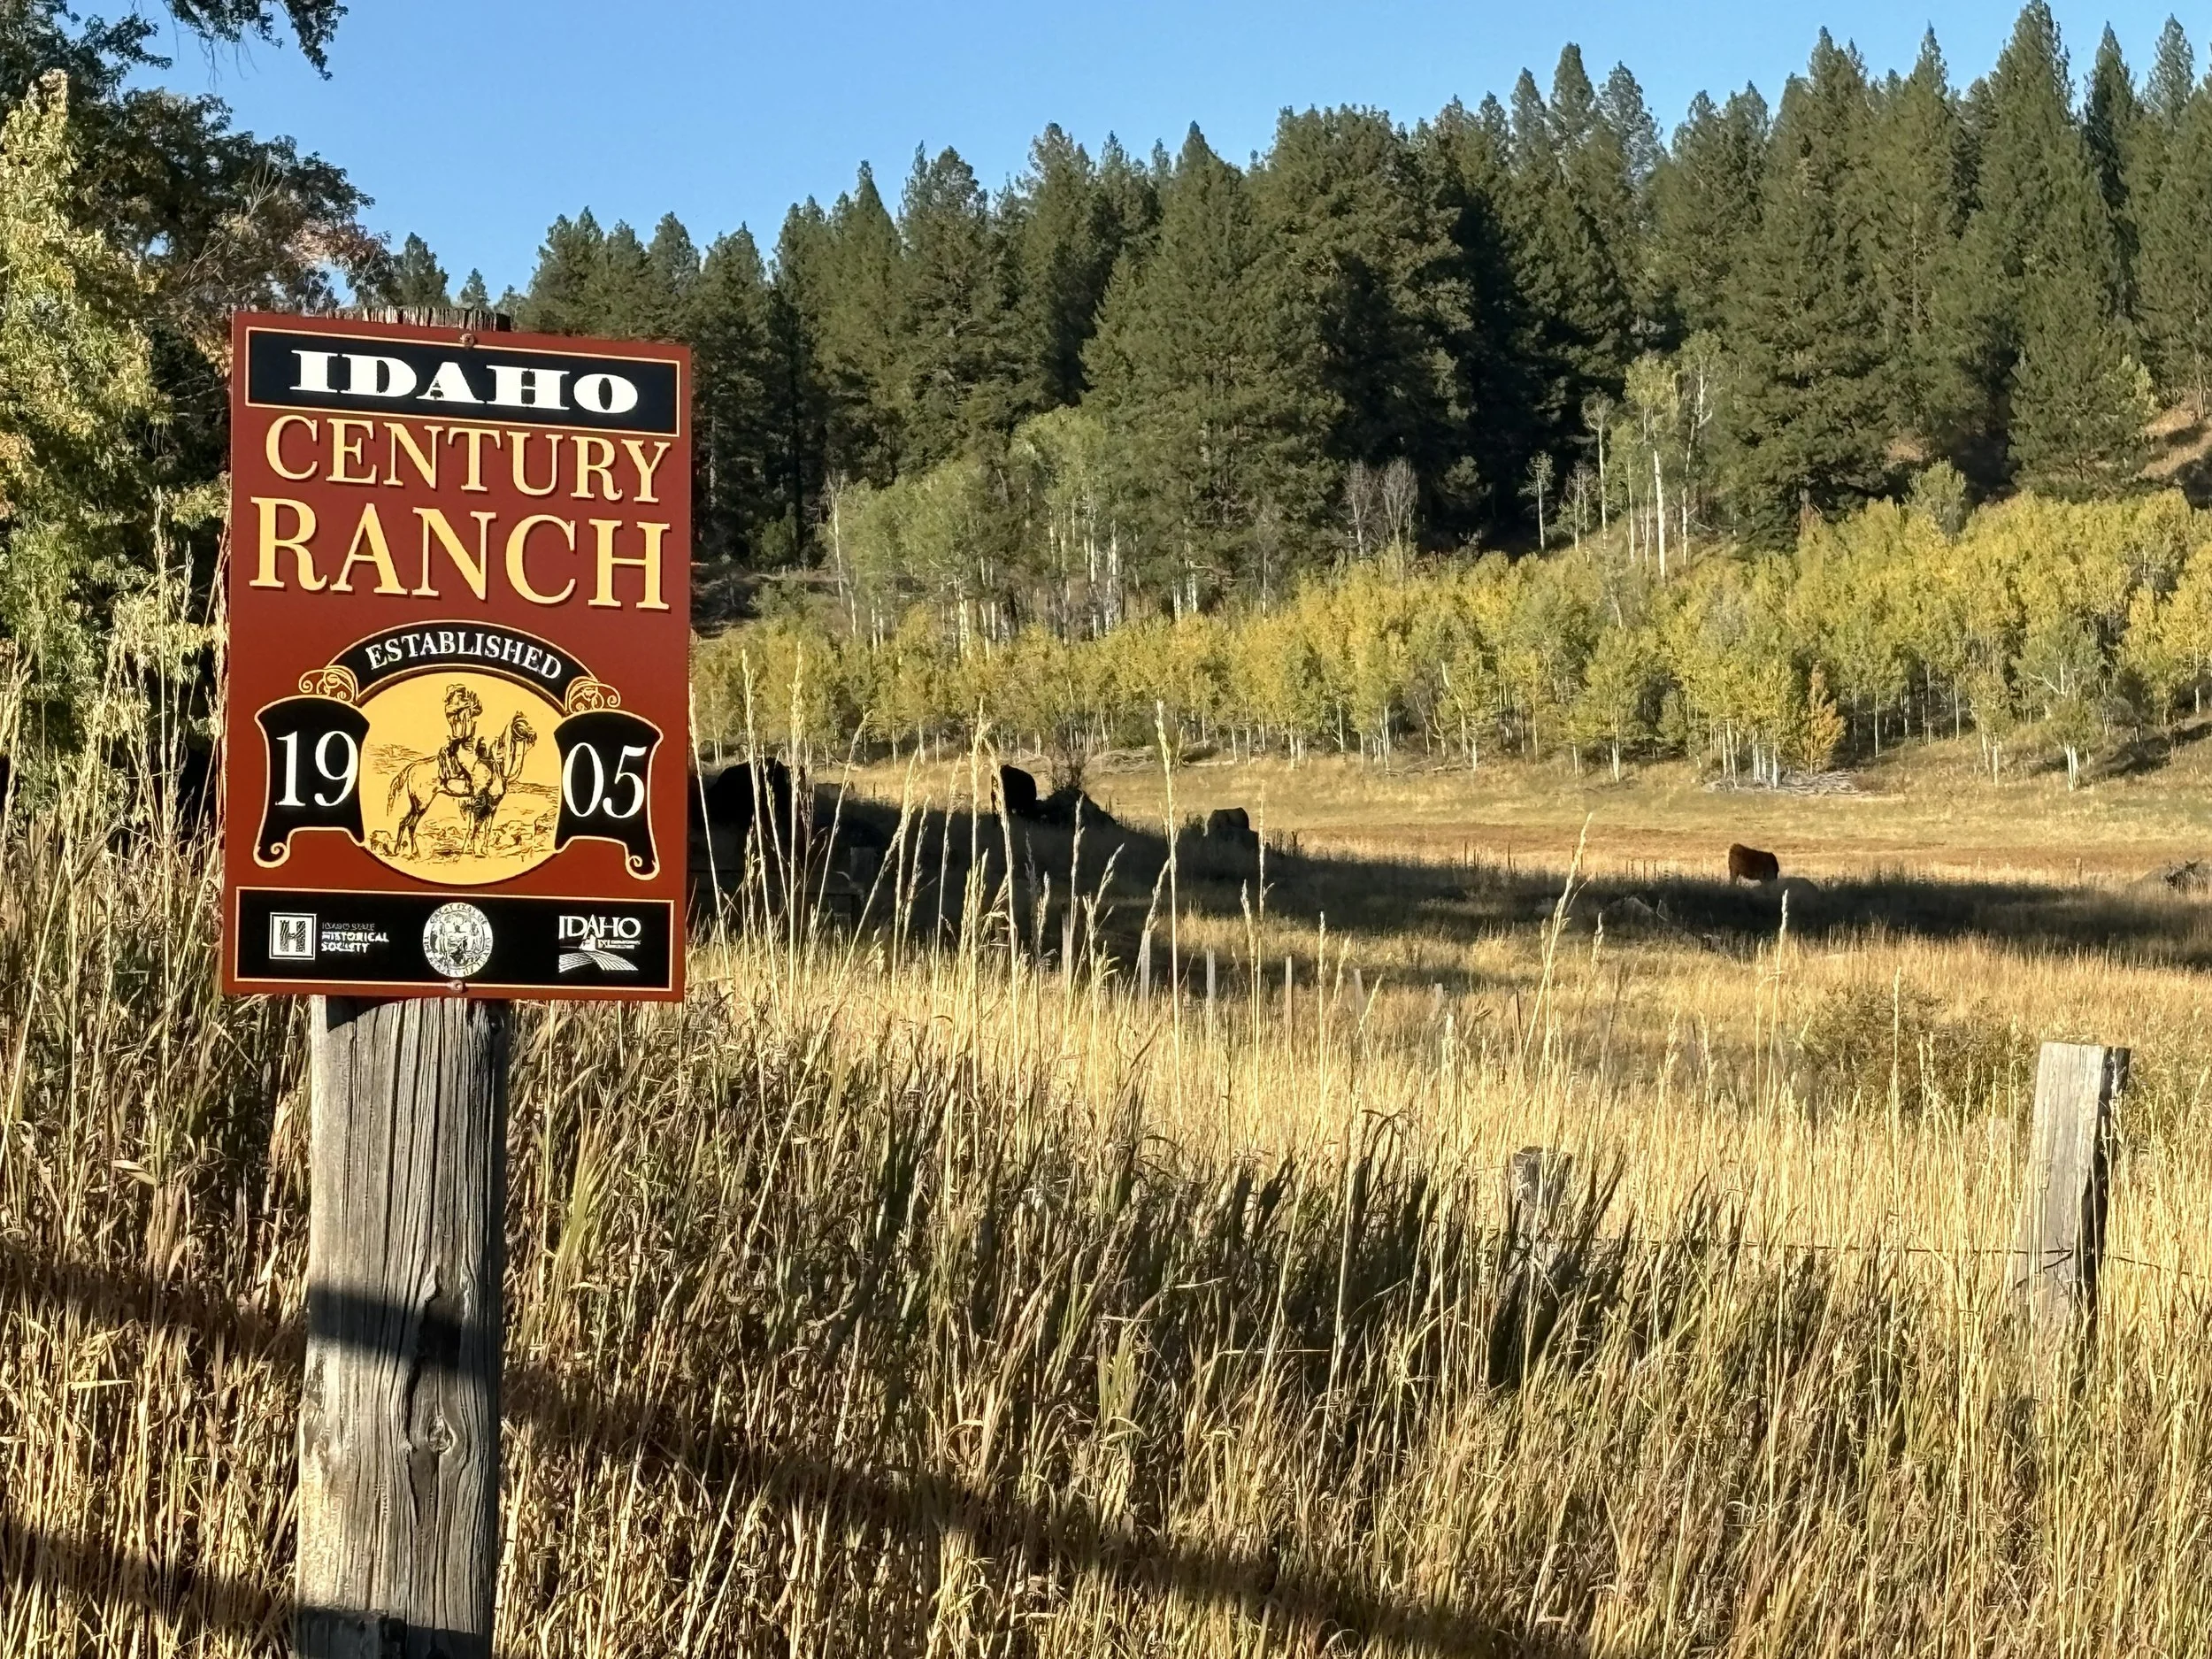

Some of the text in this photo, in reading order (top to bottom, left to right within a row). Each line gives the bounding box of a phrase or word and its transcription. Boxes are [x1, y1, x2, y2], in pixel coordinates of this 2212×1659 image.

[289, 349, 639, 414] IDAHO
[265, 414, 672, 503] CENTURY
[249, 495, 672, 611] RANCH
[365, 631, 563, 680] ESTABLISHED
[274, 730, 649, 818] 19 05
[321, 932, 390, 942] HISTORICAL
[321, 942, 371, 953] SOCIETY
[558, 914, 641, 940] IDAHO
